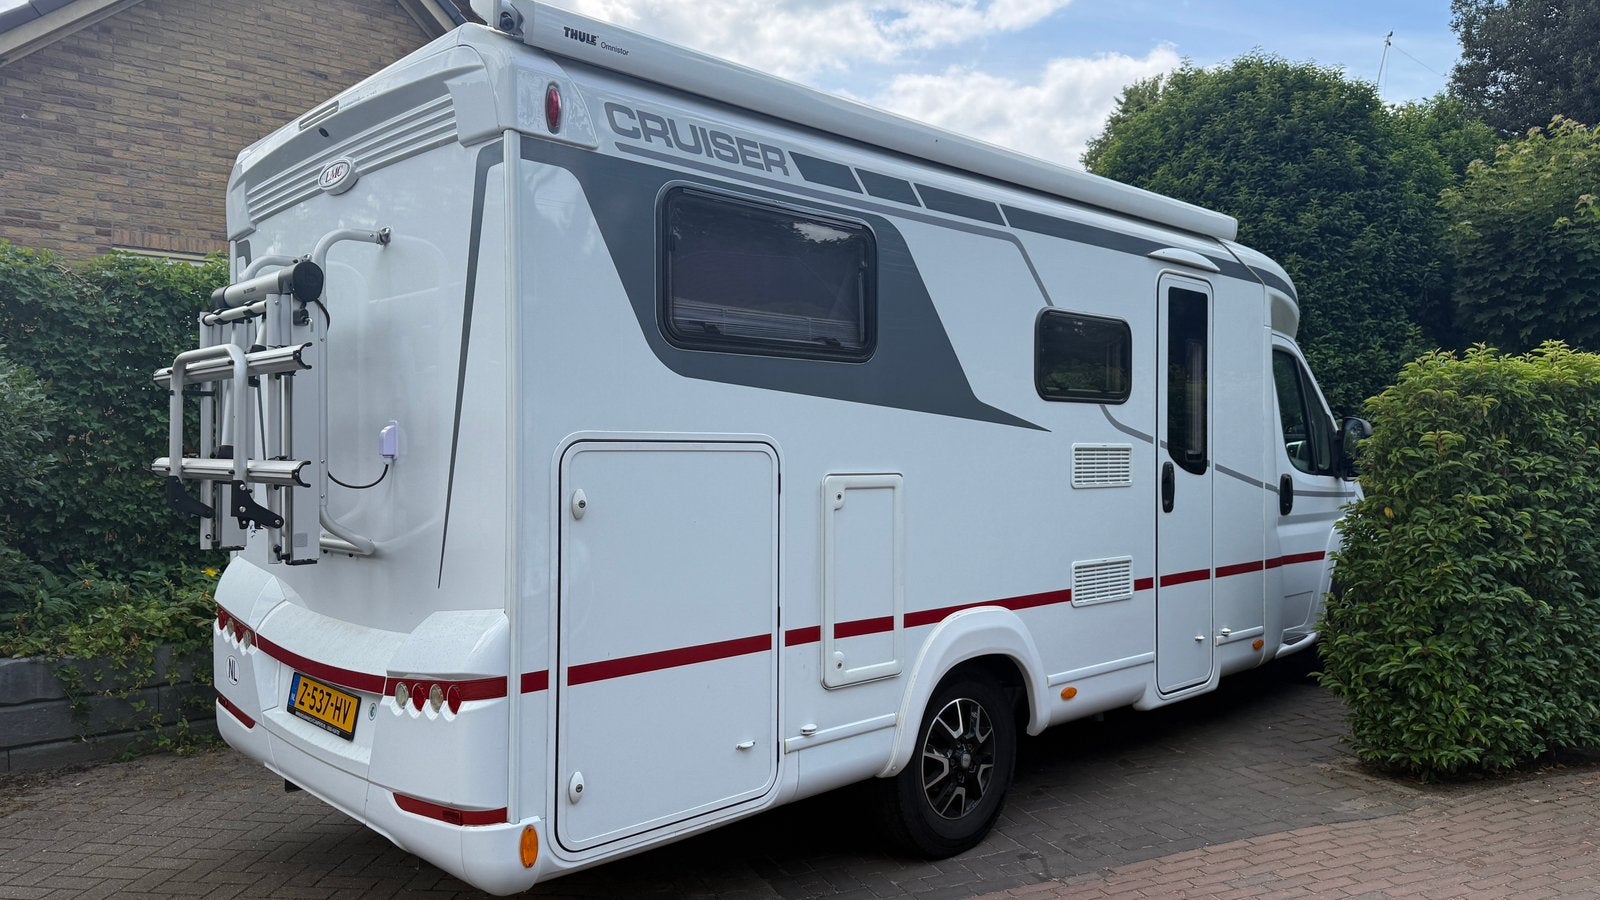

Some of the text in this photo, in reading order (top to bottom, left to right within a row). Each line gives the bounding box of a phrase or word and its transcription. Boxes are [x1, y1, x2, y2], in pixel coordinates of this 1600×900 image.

[563, 26, 629, 56] THULE Omnistor
[604, 101, 790, 177] CRUISER
[325, 164, 344, 183] LMC
[228, 658, 237, 682] NL
[298, 682, 351, 725] Z-537-HV
